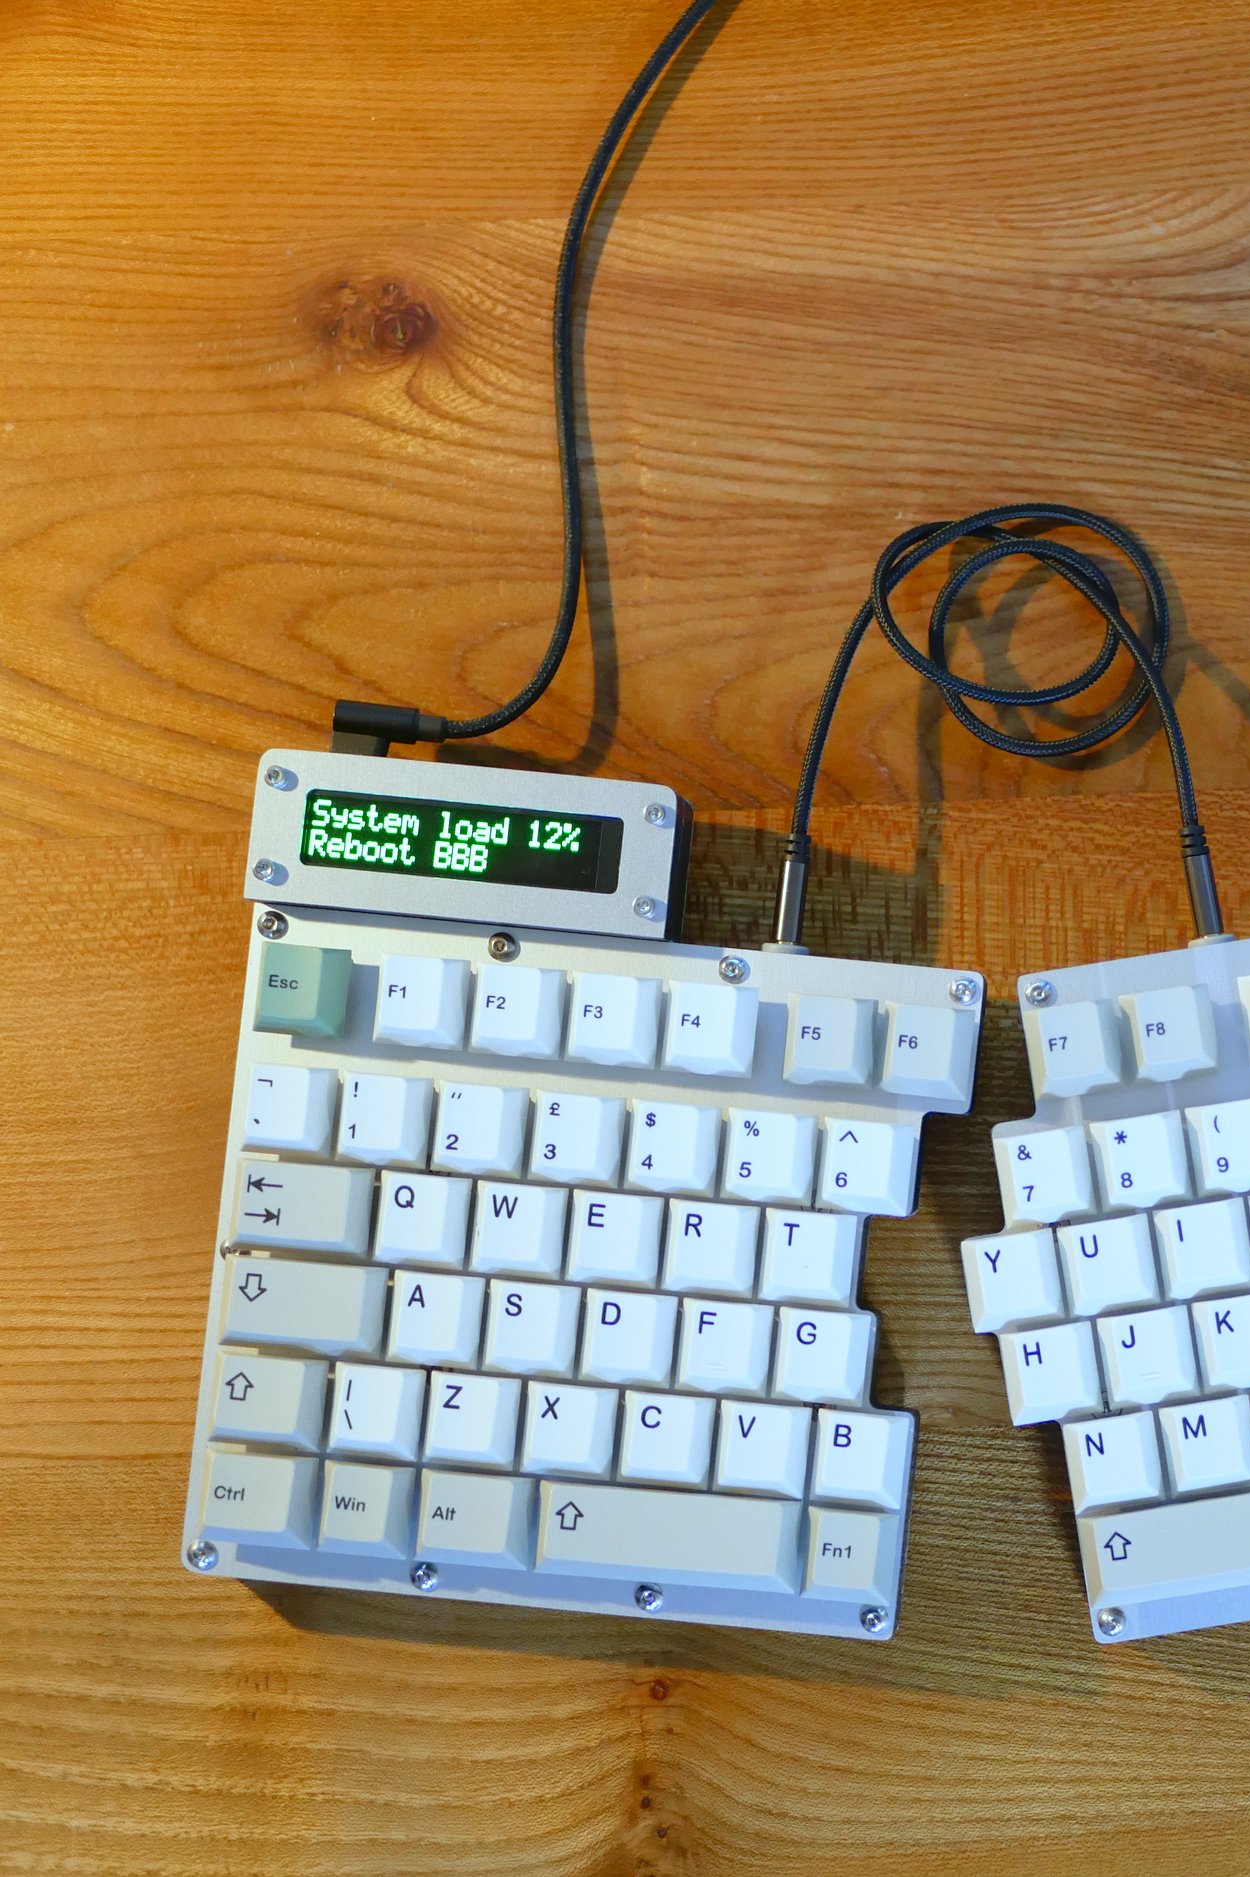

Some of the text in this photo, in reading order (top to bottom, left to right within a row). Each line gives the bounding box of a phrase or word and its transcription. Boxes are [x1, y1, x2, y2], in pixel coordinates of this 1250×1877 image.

[312, 799, 581, 852] System load 12%
[308, 829, 488, 872] Reboot BBB
[268, 974, 298, 989] Esc
[388, 985, 406, 998] F1
[486, 995, 506, 1009] F2
[584, 1005, 603, 1019] F3
[681, 1014, 700, 1028] F4
[1146, 1022, 1165, 1037] F8
[801, 1026, 821, 1040] F5
[898, 1034, 918, 1049] F6
[1048, 1036, 1067, 1052] F7
[549, 1102, 560, 1116] £
[645, 1112, 656, 1128] $
[744, 1120, 759, 1137] %
[348, 1123, 357, 1139] 1
[445, 1134, 459, 1150] 2
[544, 1144, 556, 1160] 3
[1017, 1145, 1032, 1160] &
[641, 1154, 653, 1170] 4
[739, 1162, 751, 1178] 5
[1217, 1157, 1229, 1173] 9
[835, 1172, 847, 1188] 6
[1121, 1172, 1133, 1188] 8
[394, 1185, 415, 1208] Q
[1023, 1185, 1034, 1202] 7
[493, 1194, 518, 1219] W
[587, 1203, 606, 1228] E
[684, 1213, 702, 1237] R
[783, 1223, 800, 1246] T
[1080, 1234, 1098, 1258] U
[984, 1249, 1000, 1273] Y
[408, 1284, 425, 1308] A
[505, 1293, 522, 1317] S
[601, 1302, 621, 1325] D
[698, 1311, 717, 1334] F
[1215, 1310, 1234, 1334] K
[796, 1321, 817, 1345] G
[1122, 1325, 1135, 1349] J
[1023, 1342, 1042, 1366] H
[443, 1385, 463, 1409] Z
[541, 1395, 560, 1420] X
[641, 1405, 662, 1429] C
[738, 1415, 756, 1438] V
[1182, 1414, 1207, 1440] M
[833, 1424, 852, 1448] B
[1085, 1432, 1104, 1457] N
[214, 1486, 245, 1501] Ctrl
[335, 1496, 365, 1512] Win
[432, 1506, 456, 1521] Alt
[822, 1543, 851, 1558] Fn1
